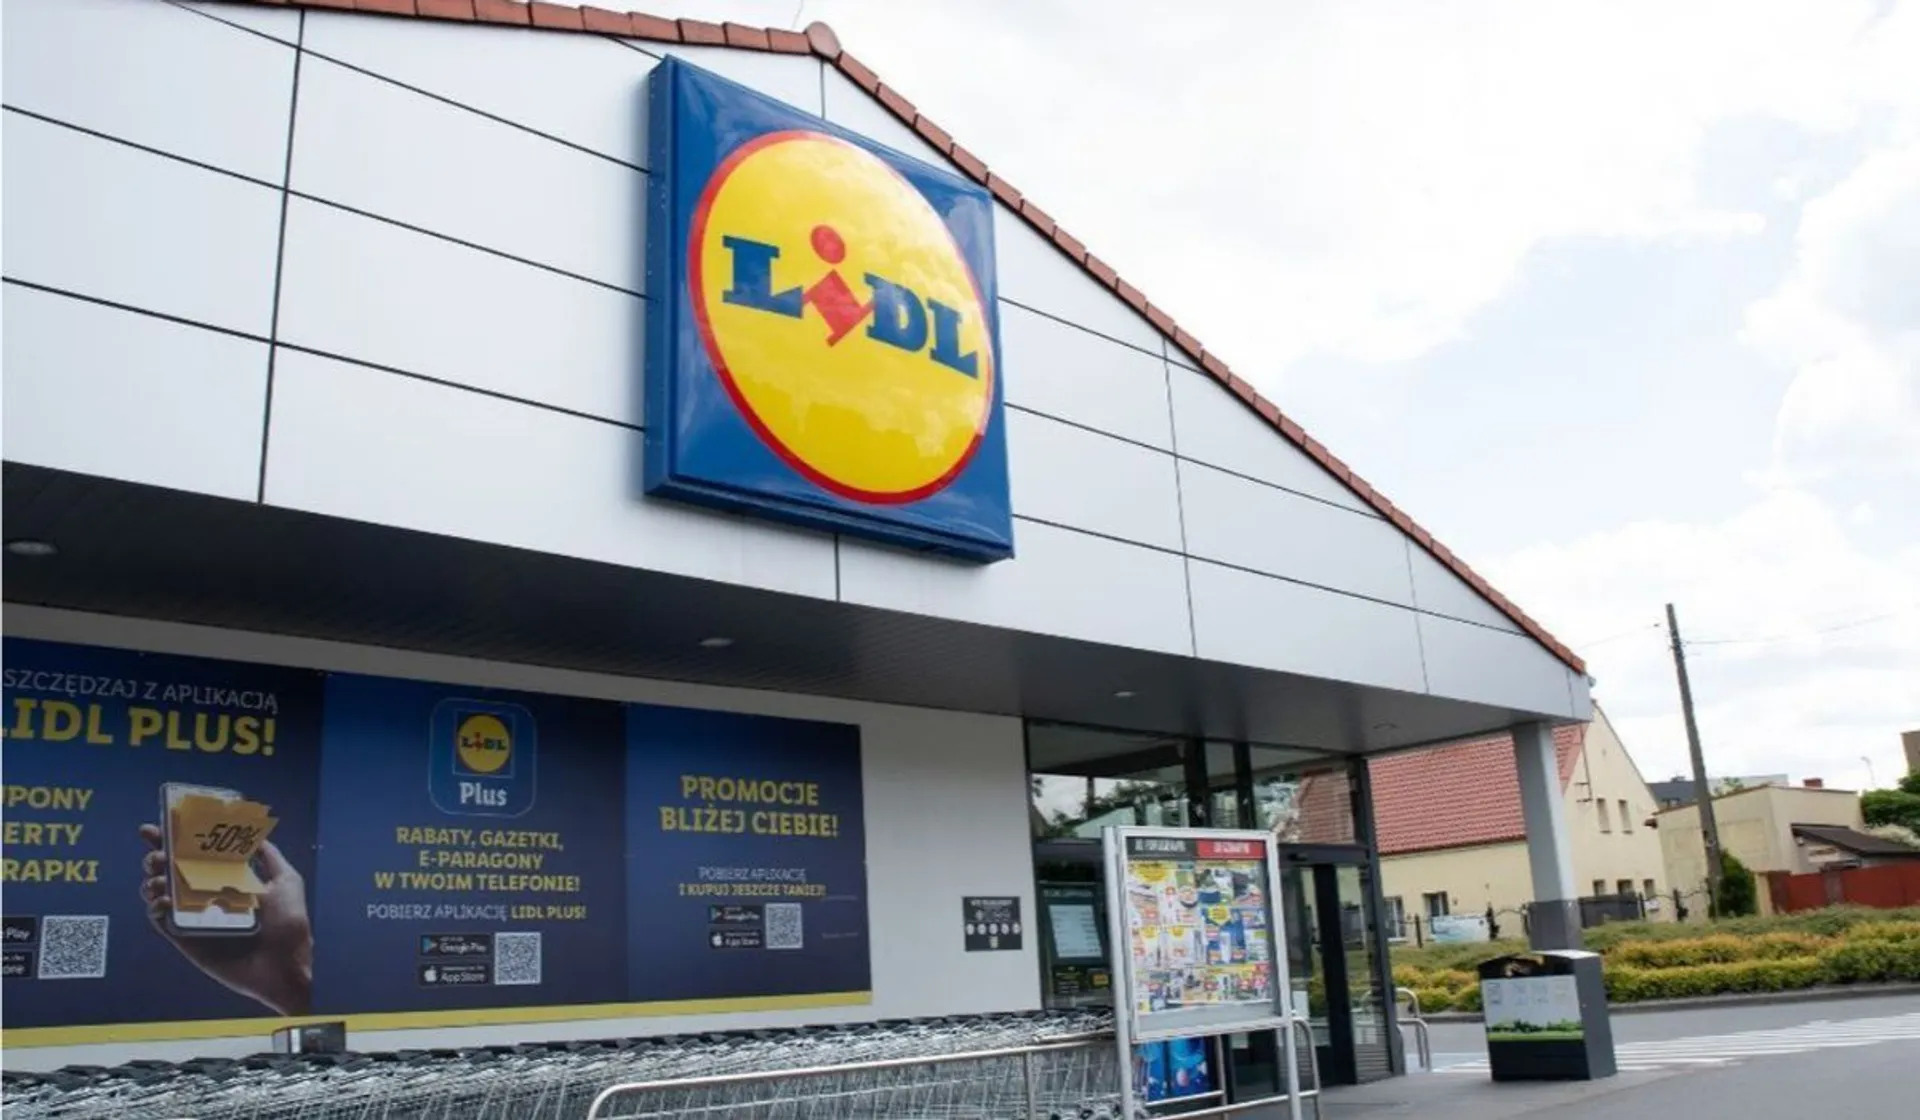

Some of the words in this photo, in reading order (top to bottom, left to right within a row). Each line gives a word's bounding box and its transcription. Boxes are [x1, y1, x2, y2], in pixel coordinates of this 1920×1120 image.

[143, 682, 157, 700] Z
[162, 684, 280, 714] APLIKACJĄ
[1, 697, 114, 744] IDL
[128, 706, 276, 756] PLUS!
[459, 782, 508, 807] Plus
[680, 774, 820, 806] PROMOCJE
[659, 803, 746, 834] BLIŻEJ
[751, 810, 839, 839] CIEBIE!
[194, 822, 262, 856] -50%
[396, 827, 476, 848] RABATY,
[479, 829, 565, 851] GAZETKI,
[418, 850, 544, 870] E-PARAGONY
[374, 871, 395, 890] W
[398, 871, 473, 891] TWOIM
[475, 873, 581, 893] TELEFONIE!
[366, 903, 433, 920] POBIERZ
[434, 903, 508, 922] APLIKACJĘ
[511, 905, 545, 920] LIDL
[547, 905, 588, 920] PLUS!
